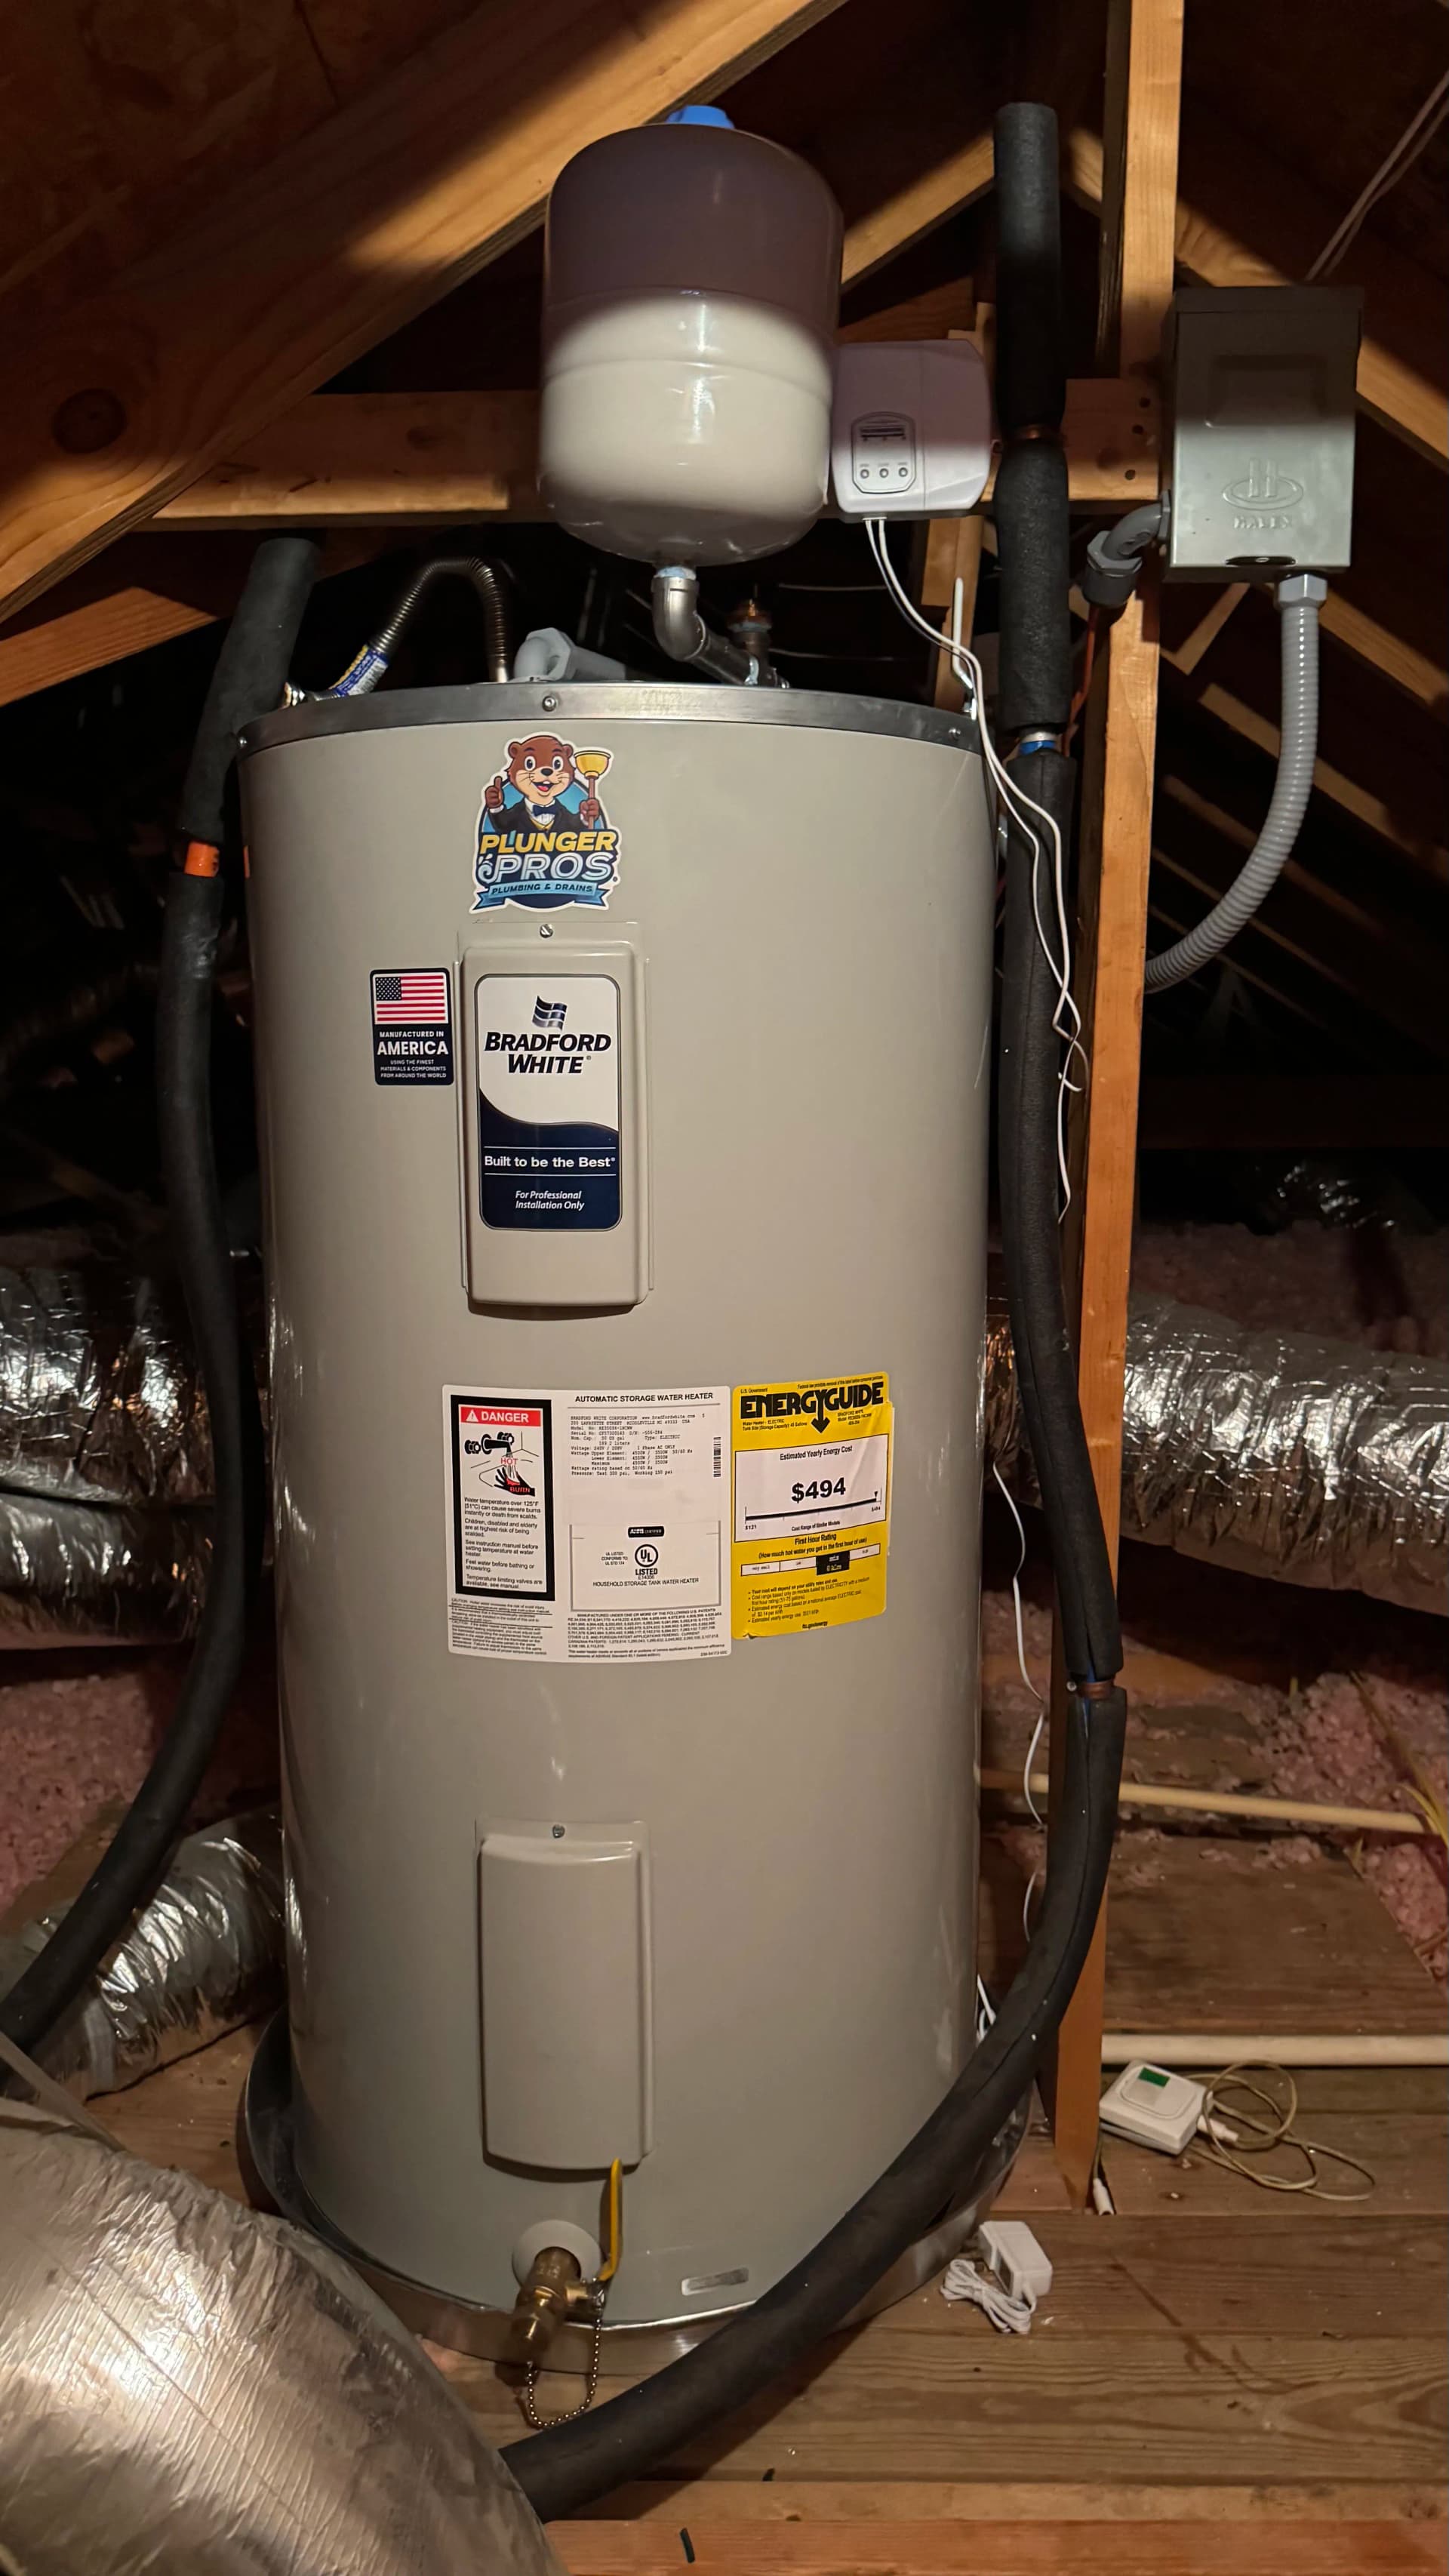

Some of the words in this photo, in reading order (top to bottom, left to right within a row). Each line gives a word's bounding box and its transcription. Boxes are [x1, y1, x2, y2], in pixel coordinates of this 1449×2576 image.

[480, 830, 617, 854] PLUNGER
[478, 852, 614, 883] PROS
[492, 883, 540, 894] PLUMBING
[555, 883, 592, 892] DRAINS
[485, 1031, 611, 1051] BRADFORD
[377, 1042, 448, 1055] AMERICA
[508, 1054, 583, 1073] WHITE
[485, 1156, 511, 1167] Built
[515, 1156, 527, 1167] to
[531, 1156, 548, 1167] be
[552, 1156, 575, 1167] the
[515, 1191, 528, 1199] For
[530, 1190, 582, 1199] Professional
[515, 1201, 562, 1209] Installation
[564, 1202, 584, 1211] Only
[740, 1381, 884, 1419] ENERGYGUIDE
[481, 1411, 529, 1423] DANGER
[780, 1452, 806, 1460] Estimated
[808, 1450, 822, 1458] Yearly
[823, 1448, 840, 1457] Energy
[791, 1477, 846, 1503] $494
[821, 1533, 836, 1541] Rating
[640, 1549, 653, 1562] UL
[758, 1551, 771, 1559] (How
